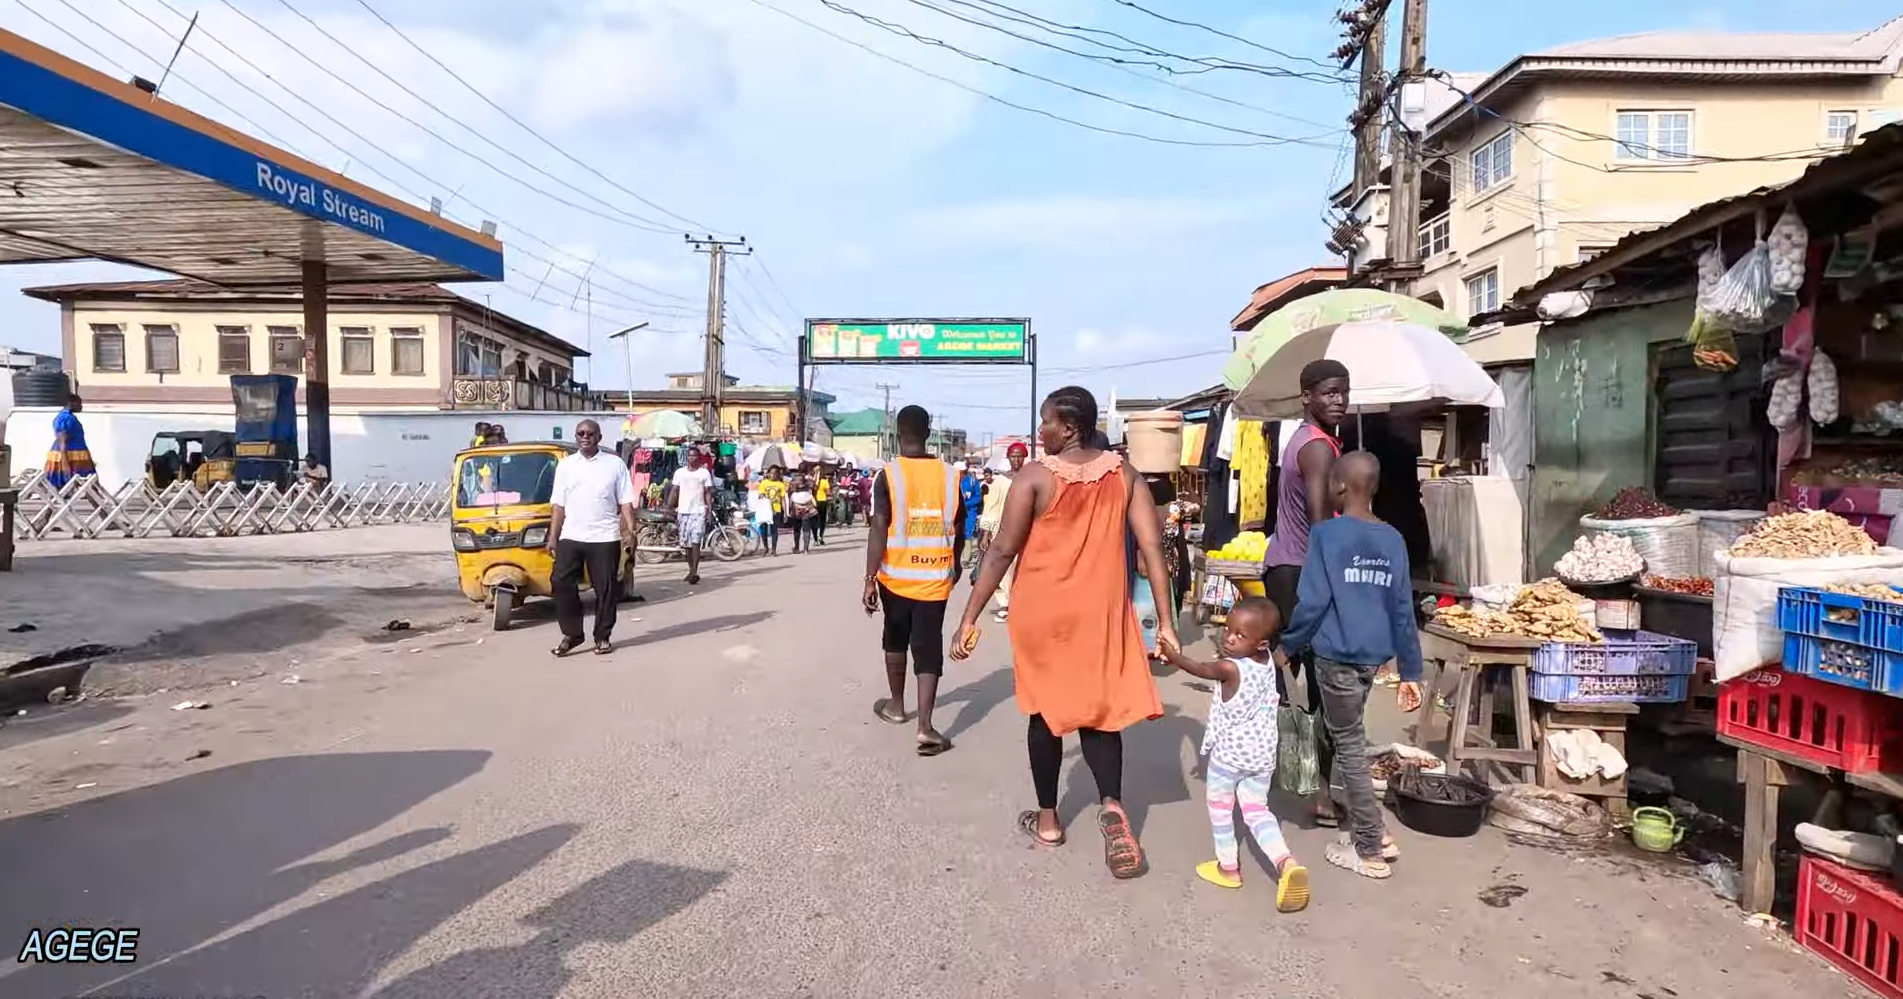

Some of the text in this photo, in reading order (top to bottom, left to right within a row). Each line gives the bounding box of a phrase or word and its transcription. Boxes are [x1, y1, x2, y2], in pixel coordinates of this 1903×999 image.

[256, 161, 386, 233] Royal Stream
[887, 324, 936, 340] KIVO
[278, 343, 284, 351] 2
[911, 555, 937, 564] Buy
